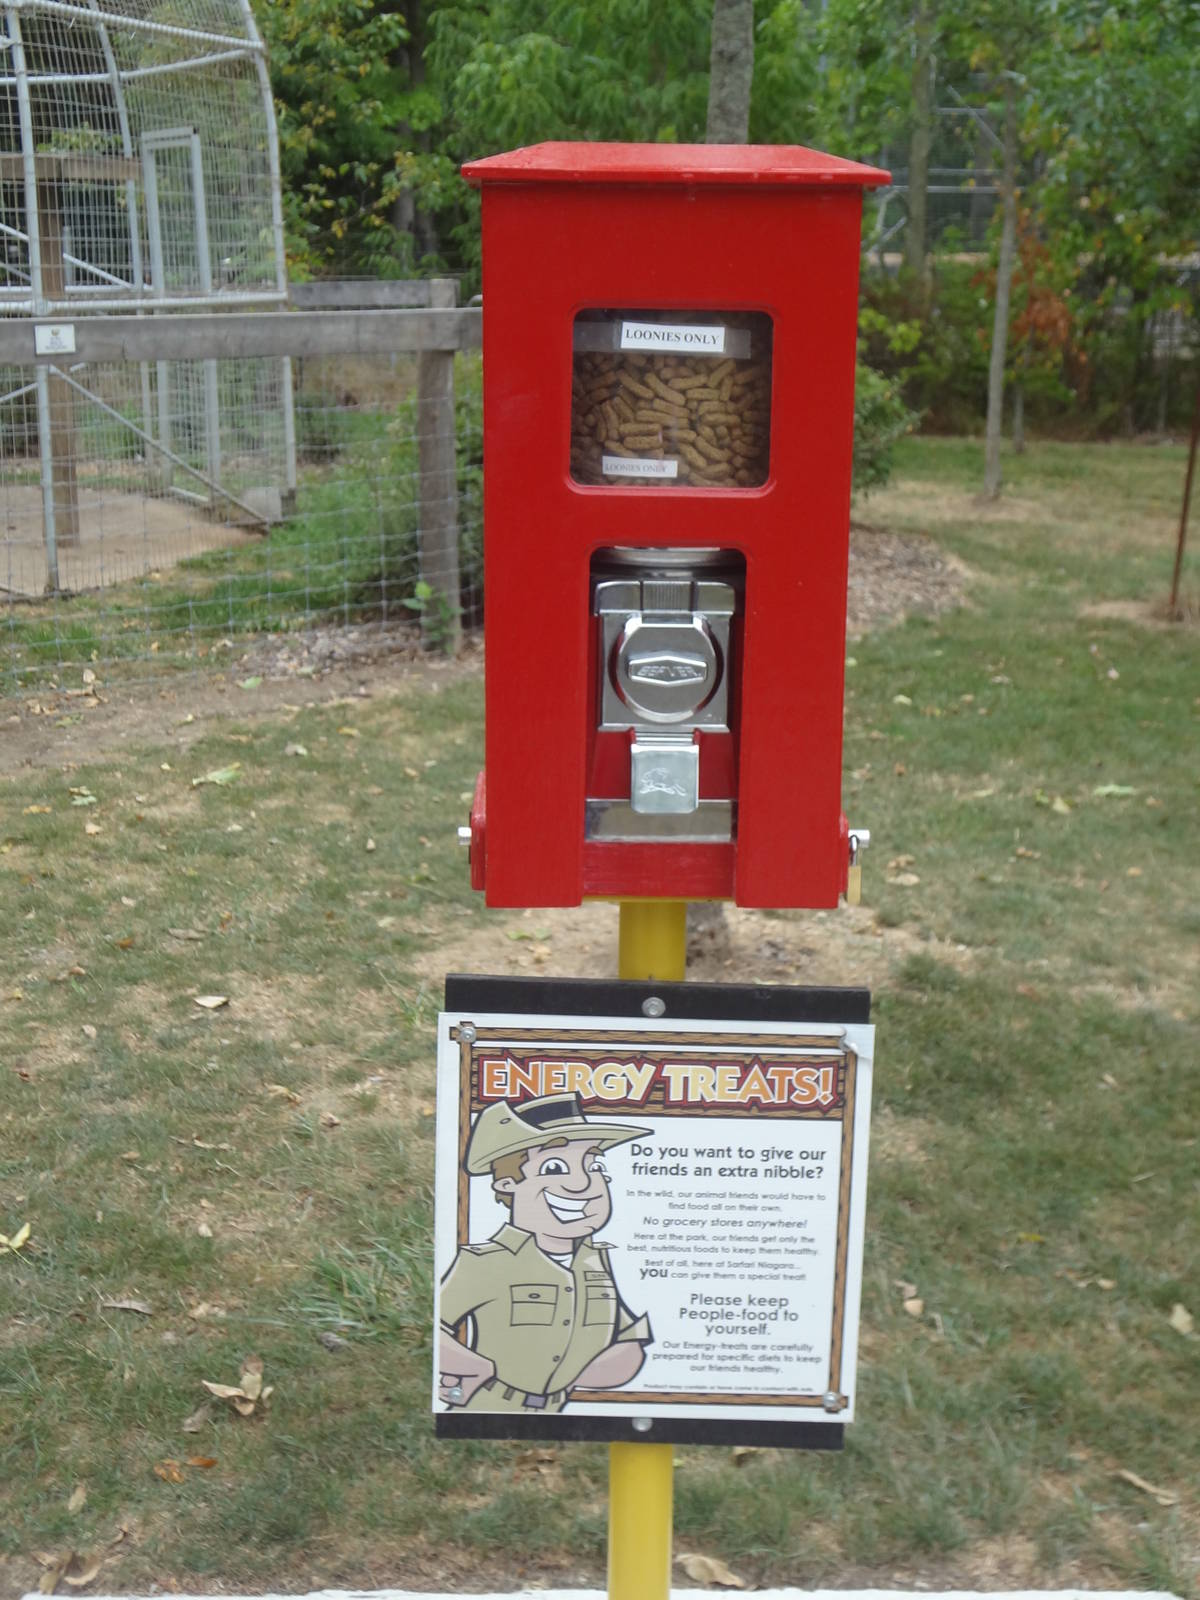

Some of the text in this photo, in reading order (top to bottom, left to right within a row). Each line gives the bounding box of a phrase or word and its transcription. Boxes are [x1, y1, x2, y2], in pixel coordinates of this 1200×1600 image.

[625, 328, 720, 345] LOONIES ONLY
[604, 462, 642, 472] LOONIES
[482, 1055, 835, 1106] ENERGY TREATS!
[630, 1143, 827, 1162] Do you want to give our
[631, 1162, 824, 1179] friends an extra nibble?
[626, 1189, 636, 1198] In
[637, 1190, 652, 1198] the
[695, 1190, 728, 1199] animal
[728, 1191, 759, 1200] friends
[791, 1193, 815, 1201] have
[816, 1193, 826, 1201] to
[668, 1202, 686, 1210] find
[687, 1203, 710, 1211] food
[711, 1203, 723, 1211] all
[738, 1204, 758, 1212] their
[643, 1216, 808, 1230] No grocery stores anywhere!
[633, 1232, 656, 1240] Here
[669, 1233, 684, 1241] the
[761, 1236, 777, 1244] get
[800, 1236, 815, 1244] the
[651, 1245, 692, 1253] nutritious
[732, 1247, 757, 1255] keep
[758, 1247, 782, 1255] them
[645, 1259, 663, 1267] Best
[692, 1260, 713, 1268] here
[727, 1260, 756, 1269] Safari
[639, 1267, 668, 1280] you
[691, 1271, 712, 1280] give
[713, 1272, 737, 1280] them
[748, 1273, 780, 1282] special
[690, 1293, 789, 1309] Please keep
[679, 1307, 799, 1322] People-food to
[705, 1322, 772, 1337] yourself.
[662, 1341, 680, 1349] Our
[770, 1343, 814, 1353] carefully
[652, 1352, 699, 1361] prepared
[701, 1353, 714, 1361] for
[717, 1353, 755, 1364] specific
[758, 1354, 781, 1362] diets
[796, 1355, 822, 1364] keep
[708, 1364, 741, 1372] friends
